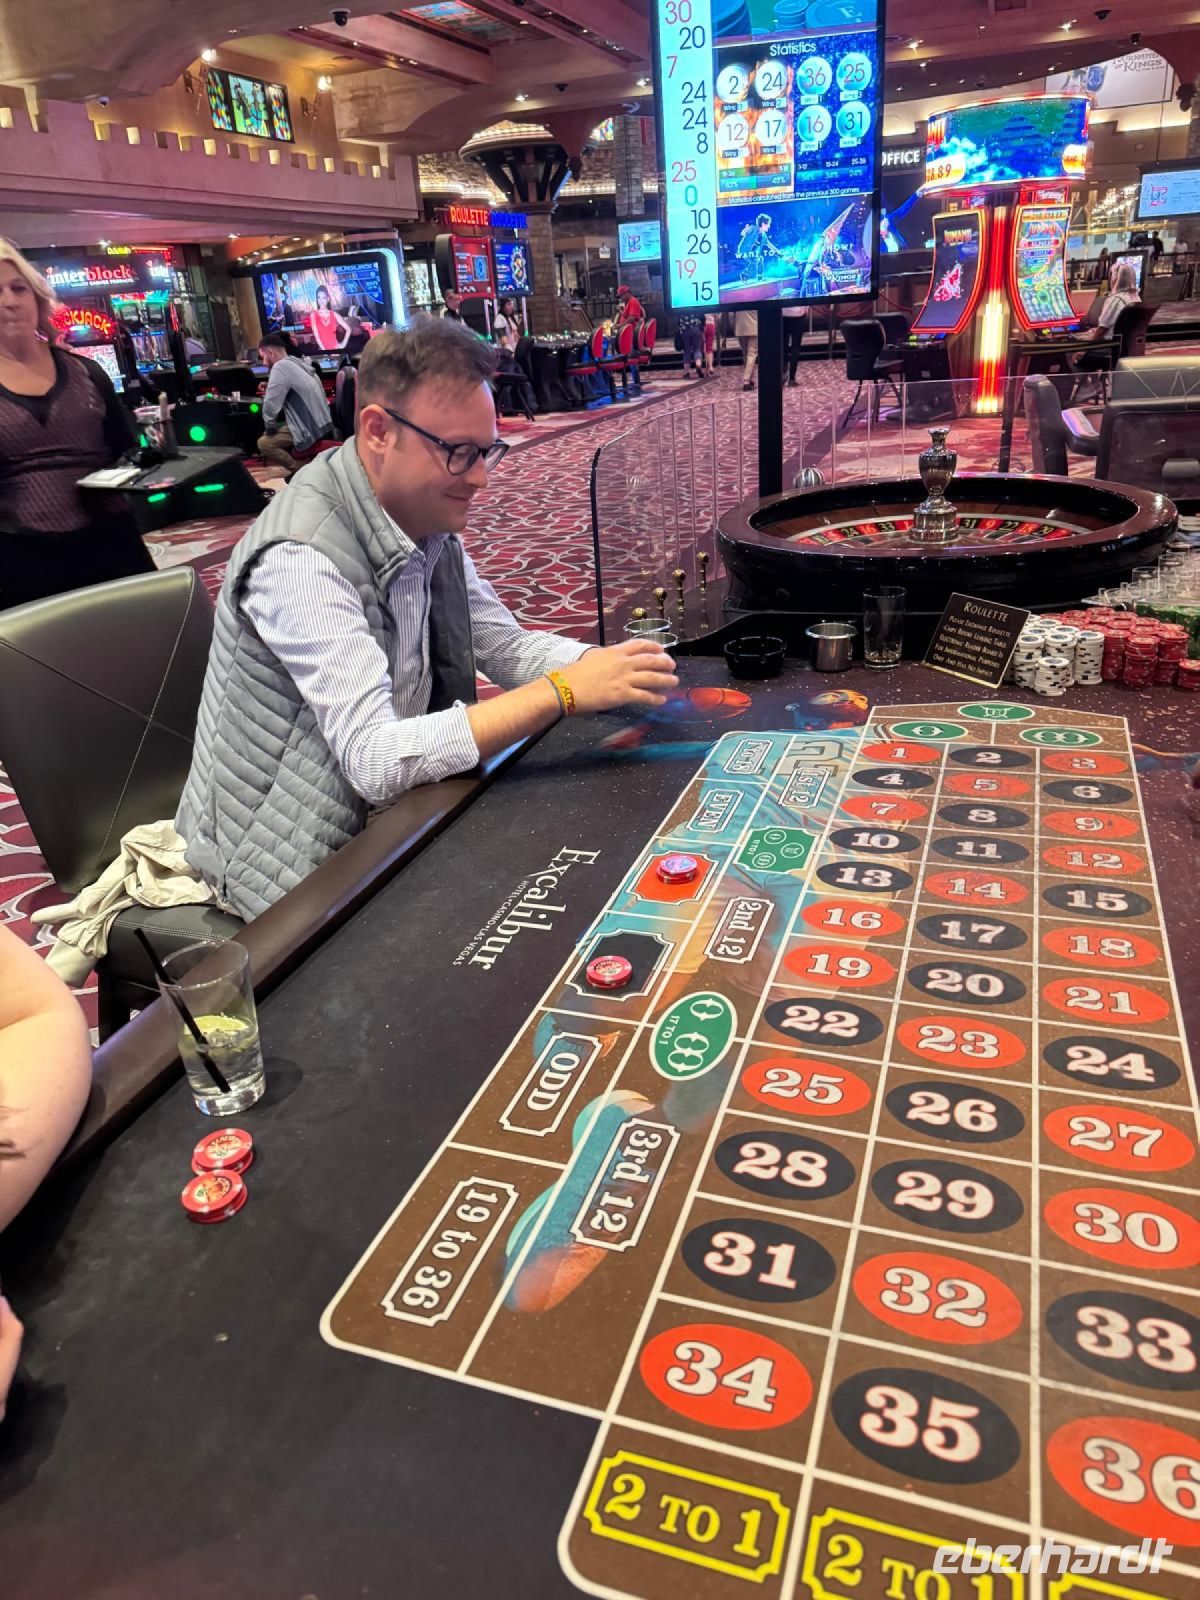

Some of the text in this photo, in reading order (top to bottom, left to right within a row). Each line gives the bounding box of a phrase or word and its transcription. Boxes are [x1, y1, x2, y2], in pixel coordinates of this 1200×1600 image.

[665, 0, 692, 24] 30
[679, 25, 706, 50] 20
[770, 42, 816, 57] Statistics
[666, 56, 678, 78] 7
[1123, 58, 1162, 72] KINGS
[729, 62, 865, 94] 2 24 36 25
[681, 80, 707, 104] 24
[682, 107, 708, 130] 24
[723, 104, 737, 112] Wins
[727, 112, 863, 141] 12 17 16 31
[696, 133, 709, 154] 8
[672, 161, 697, 182] 25
[684, 185, 698, 206] 0
[796, 191, 805, 199] the
[805, 189, 829, 199] previous
[840, 187, 860, 196] games
[450, 206, 489, 226] ROULETTE
[690, 209, 711, 229] 10
[687, 234, 712, 255] 26
[46, 264, 133, 285] interblock
[675, 259, 697, 279] 19
[692, 281, 713, 301] 15
[879, 521, 896, 532] 33
[962, 519, 977, 529] 31
[963, 601, 1009, 622] ROULETTE
[988, 625, 1012, 637] ROULETTE
[910, 725, 944, 737] 0
[1032, 730, 1089, 745] 00
[890, 747, 908, 759] 1
[975, 752, 1002, 764] 2
[1071, 757, 1098, 770] 3
[876, 773, 904, 785] 4
[972, 778, 999, 791] 5
[789, 790, 812, 803] 12
[1072, 785, 1101, 799] 6
[698, 793, 731, 828] EVEN
[870, 801, 898, 815] 7
[967, 808, 997, 823] 8
[1074, 816, 1104, 831] 9
[850, 832, 900, 849] 10
[956, 841, 1002, 859] 11
[1066, 850, 1123, 869] 12
[835, 867, 892, 888] 13
[948, 878, 1006, 899] 14
[468, 846, 601, 970] Excalibur
[1066, 889, 1129, 912] 15
[452, 880, 530, 967] HOTEL CASINO LAS VEGAS
[716, 900, 763, 957] 2nd 12
[822, 907, 883, 929] 16
[940, 920, 1006, 944] 17
[1068, 935, 1137, 960] 18
[806, 953, 872, 979] 19
[925, 968, 1005, 997] 20
[690, 998, 725, 1021] 0
[1065, 986, 1140, 1015] 21
[662, 1025, 676, 1039] TO
[780, 1004, 860, 1038] 22
[667, 1032, 710, 1073] 00
[918, 1025, 1000, 1059] 23
[1066, 1045, 1155, 1083] 24
[526, 1051, 581, 1112] ODD
[759, 1067, 845, 1105] 25
[906, 1090, 998, 1133] 26
[1068, 1115, 1164, 1158] 27
[733, 1141, 828, 1189] 28
[589, 1129, 663, 1233] 3rd 12
[894, 1170, 995, 1220] 29
[1073, 1202, 1180, 1254] 30
[402, 1187, 499, 1310] 19 to 36
[703, 1231, 797, 1290] 31
[880, 1264, 989, 1328] 32
[1076, 1305, 1198, 1373] 33
[664, 1340, 778, 1413] 34
[860, 1385, 982, 1463] 35
[1081, 1434, 1200, 1520] 36
[603, 1472, 767, 1559] 2 TO 1
[823, 1533, 864, 1587] 2
[881, 1558, 951, 1600] TO
